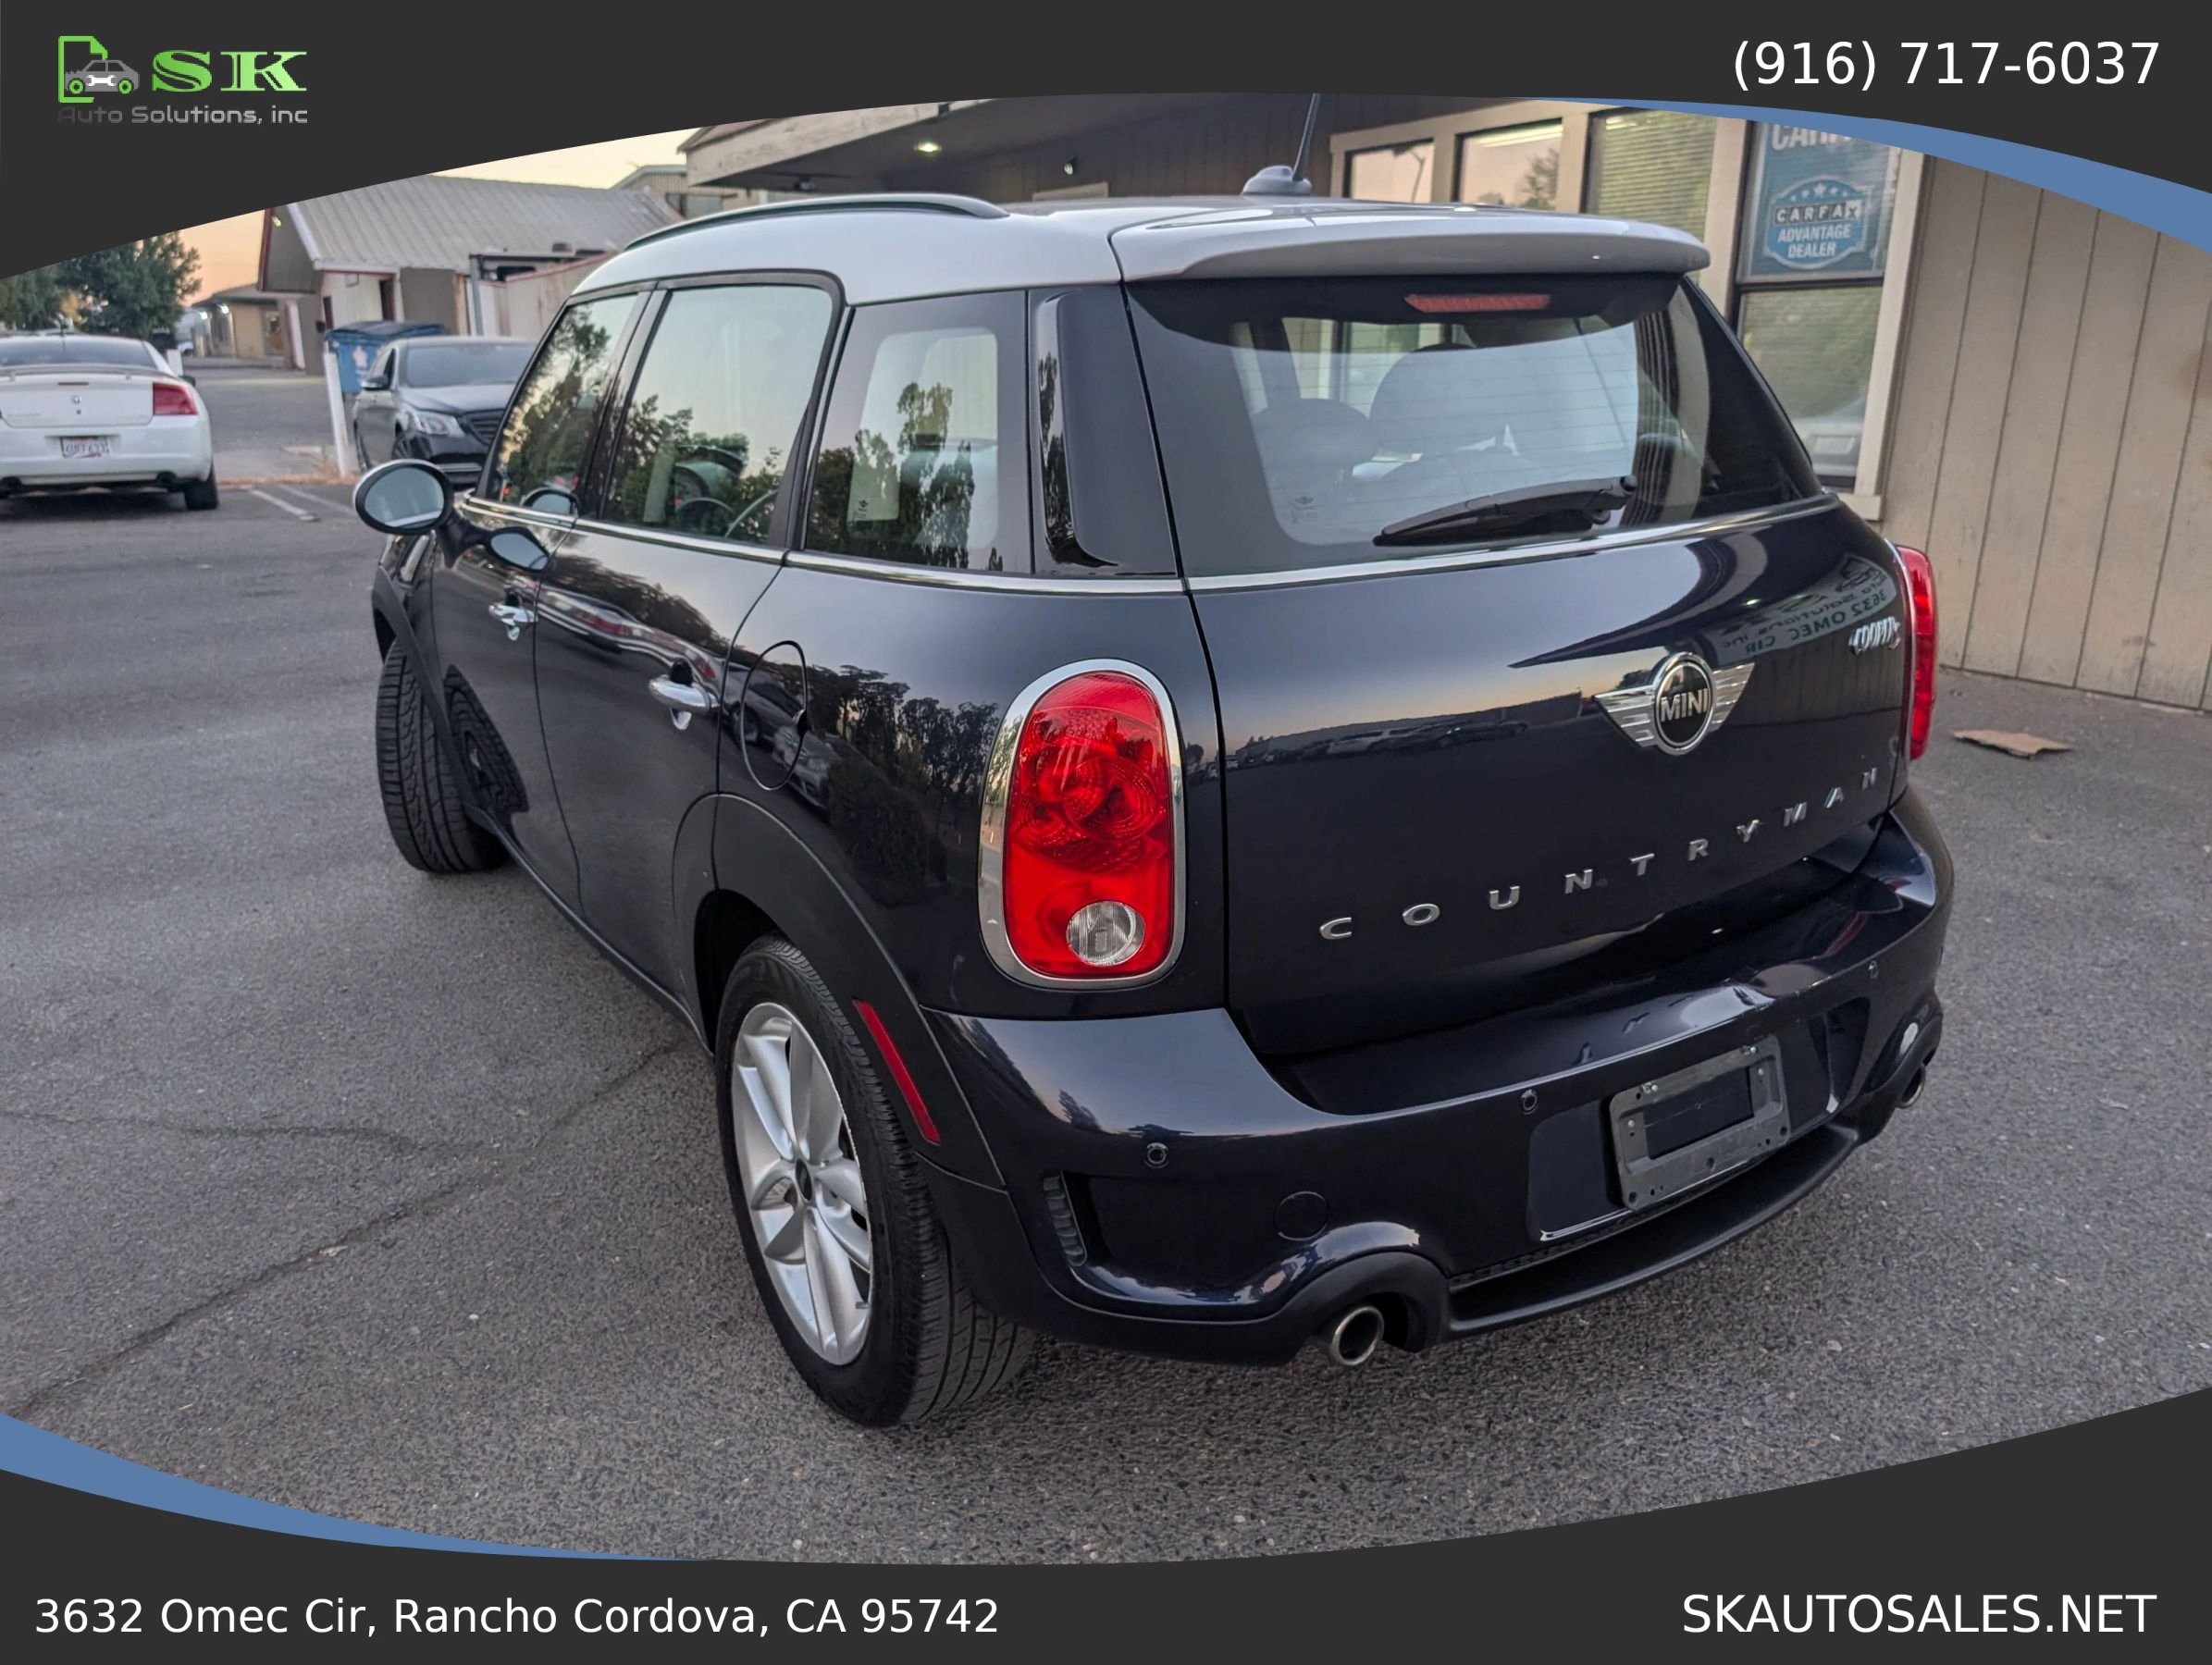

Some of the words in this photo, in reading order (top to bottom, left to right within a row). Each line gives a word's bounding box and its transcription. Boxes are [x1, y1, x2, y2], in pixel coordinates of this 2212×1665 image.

[1775, 201, 1861, 224] CARFAX
[1778, 224, 1852, 243] ADVANTAGE
[1787, 241, 1836, 259] DEALER
[1661, 687, 1710, 722] MINI
[1318, 766, 1879, 941] COUNTRYMAN
